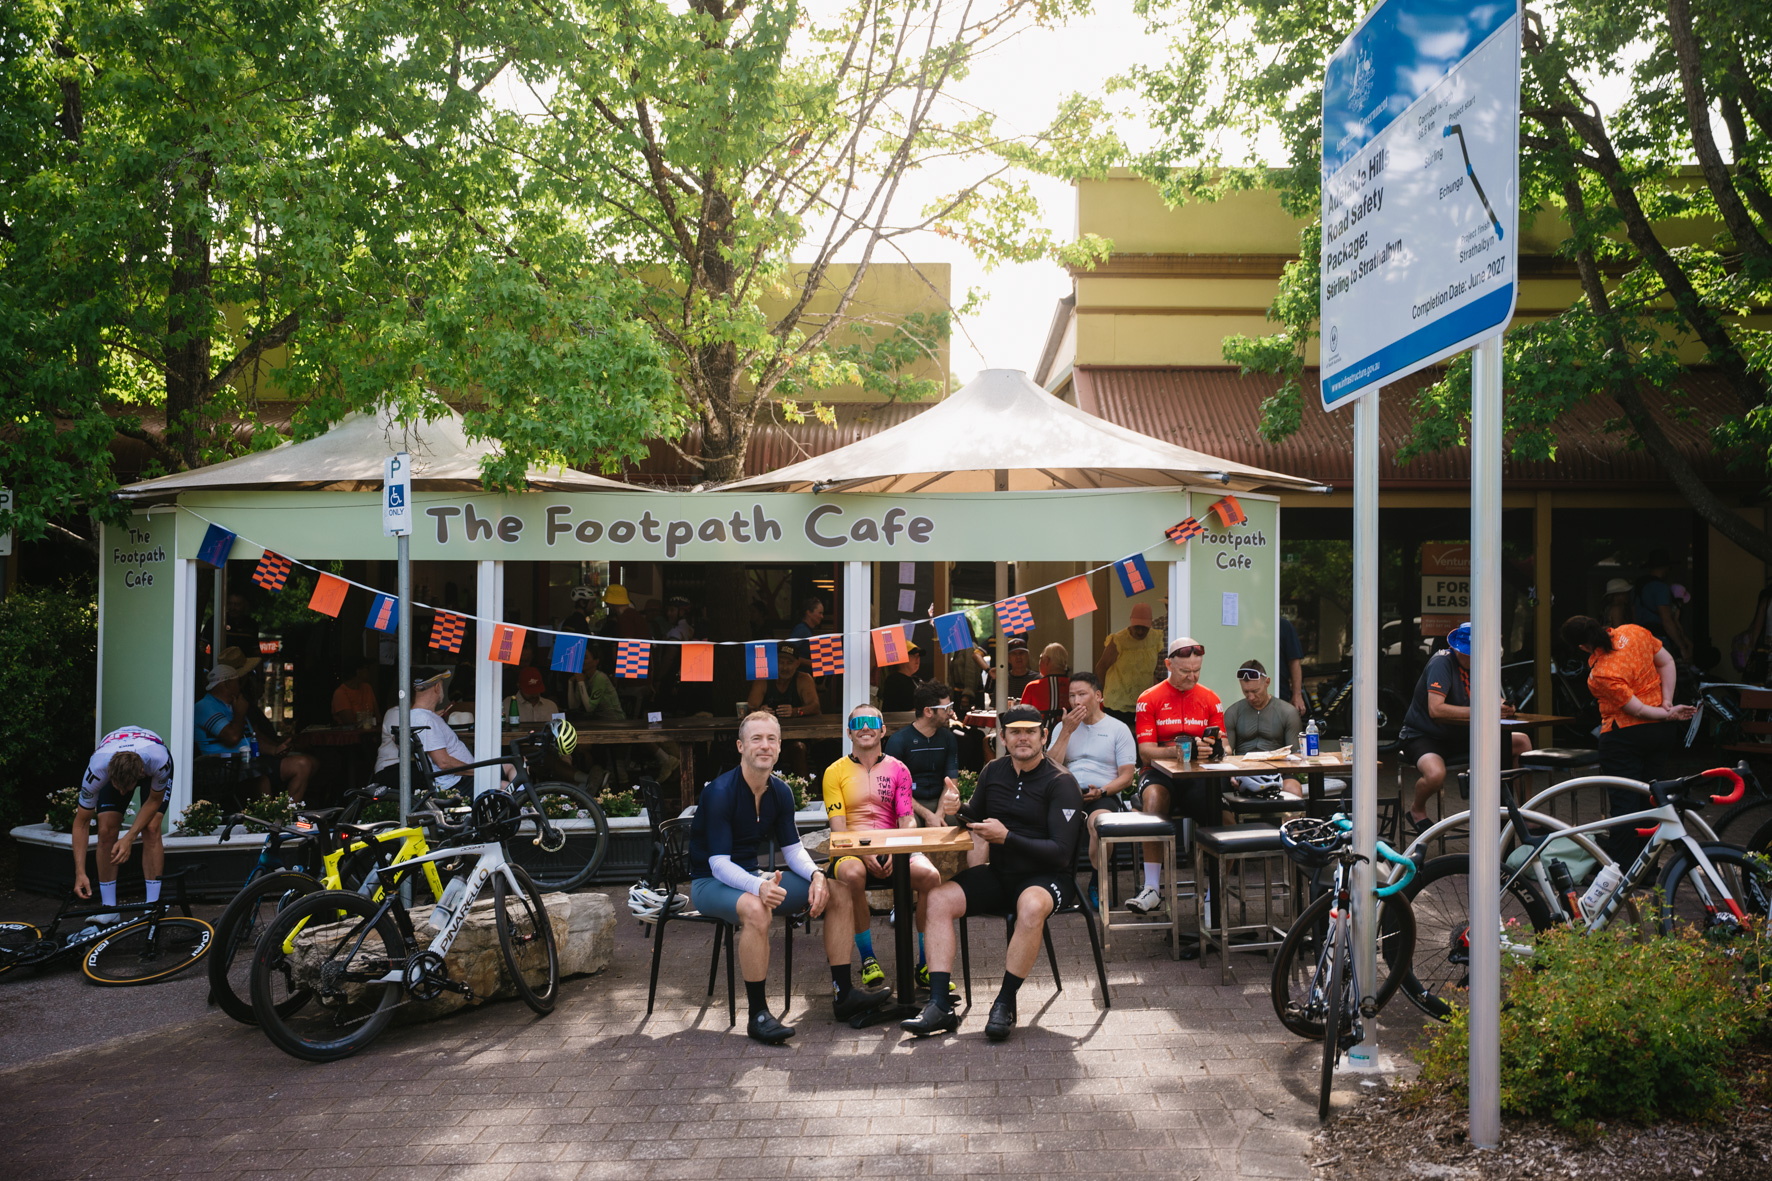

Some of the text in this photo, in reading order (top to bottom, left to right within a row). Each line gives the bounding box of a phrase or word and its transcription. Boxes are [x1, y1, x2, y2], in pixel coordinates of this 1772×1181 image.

[1368, 148, 1390, 181] Hills
[1439, 176, 1464, 200] Echunga
[1327, 186, 1384, 246] Road Safety
[1326, 230, 1368, 275] Package:
[1459, 235, 1495, 264] Strathalbyn
[1326, 238, 1403, 301] Stirling to Strathalbyn
[1411, 255, 1506, 320] Completion Date: June 2027
[390, 459, 402, 479] P
[388, 508, 405, 517] ONLY
[128, 527, 151, 545] The
[425, 503, 936, 559] The Footpath Cafe
[1201, 527, 1267, 551] Footpath
[113, 545, 166, 569] Footpath
[1215, 551, 1252, 570] Cafe
[1432, 547, 1470, 566] Ventur
[125, 570, 154, 588] Cafe
[1436, 581, 1470, 593] FOR
[1427, 595, 1470, 607] LEAS
[1156, 717, 1182, 726] Northern
[1183, 717, 1204, 727] Sydney
[876, 775, 891, 783] TEAM
[1517, 888, 1535, 904] DT
[439, 867, 489, 953] PINARELLO
[88, 939, 110, 967] roval
[191, 930, 210, 957] roval
